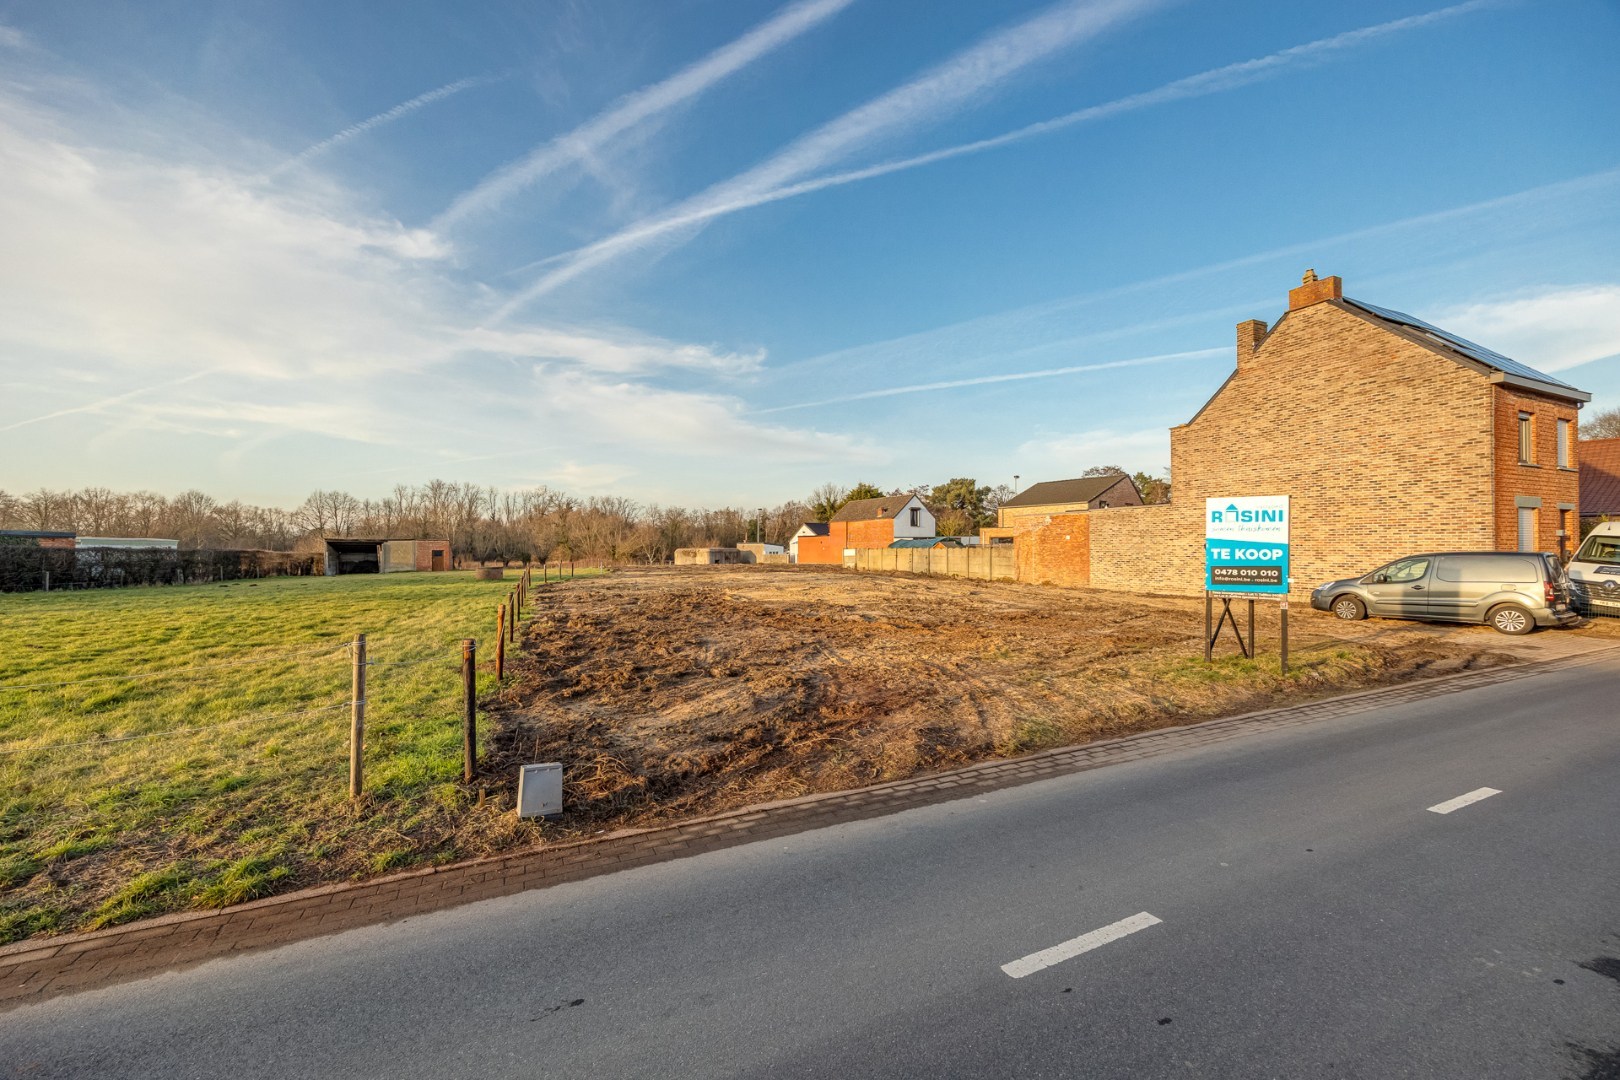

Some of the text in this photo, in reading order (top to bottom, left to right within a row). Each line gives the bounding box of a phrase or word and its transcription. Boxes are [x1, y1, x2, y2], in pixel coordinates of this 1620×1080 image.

[1211, 548, 1283, 561] TE KOOP
[1214, 568, 1238, 576] 0478
